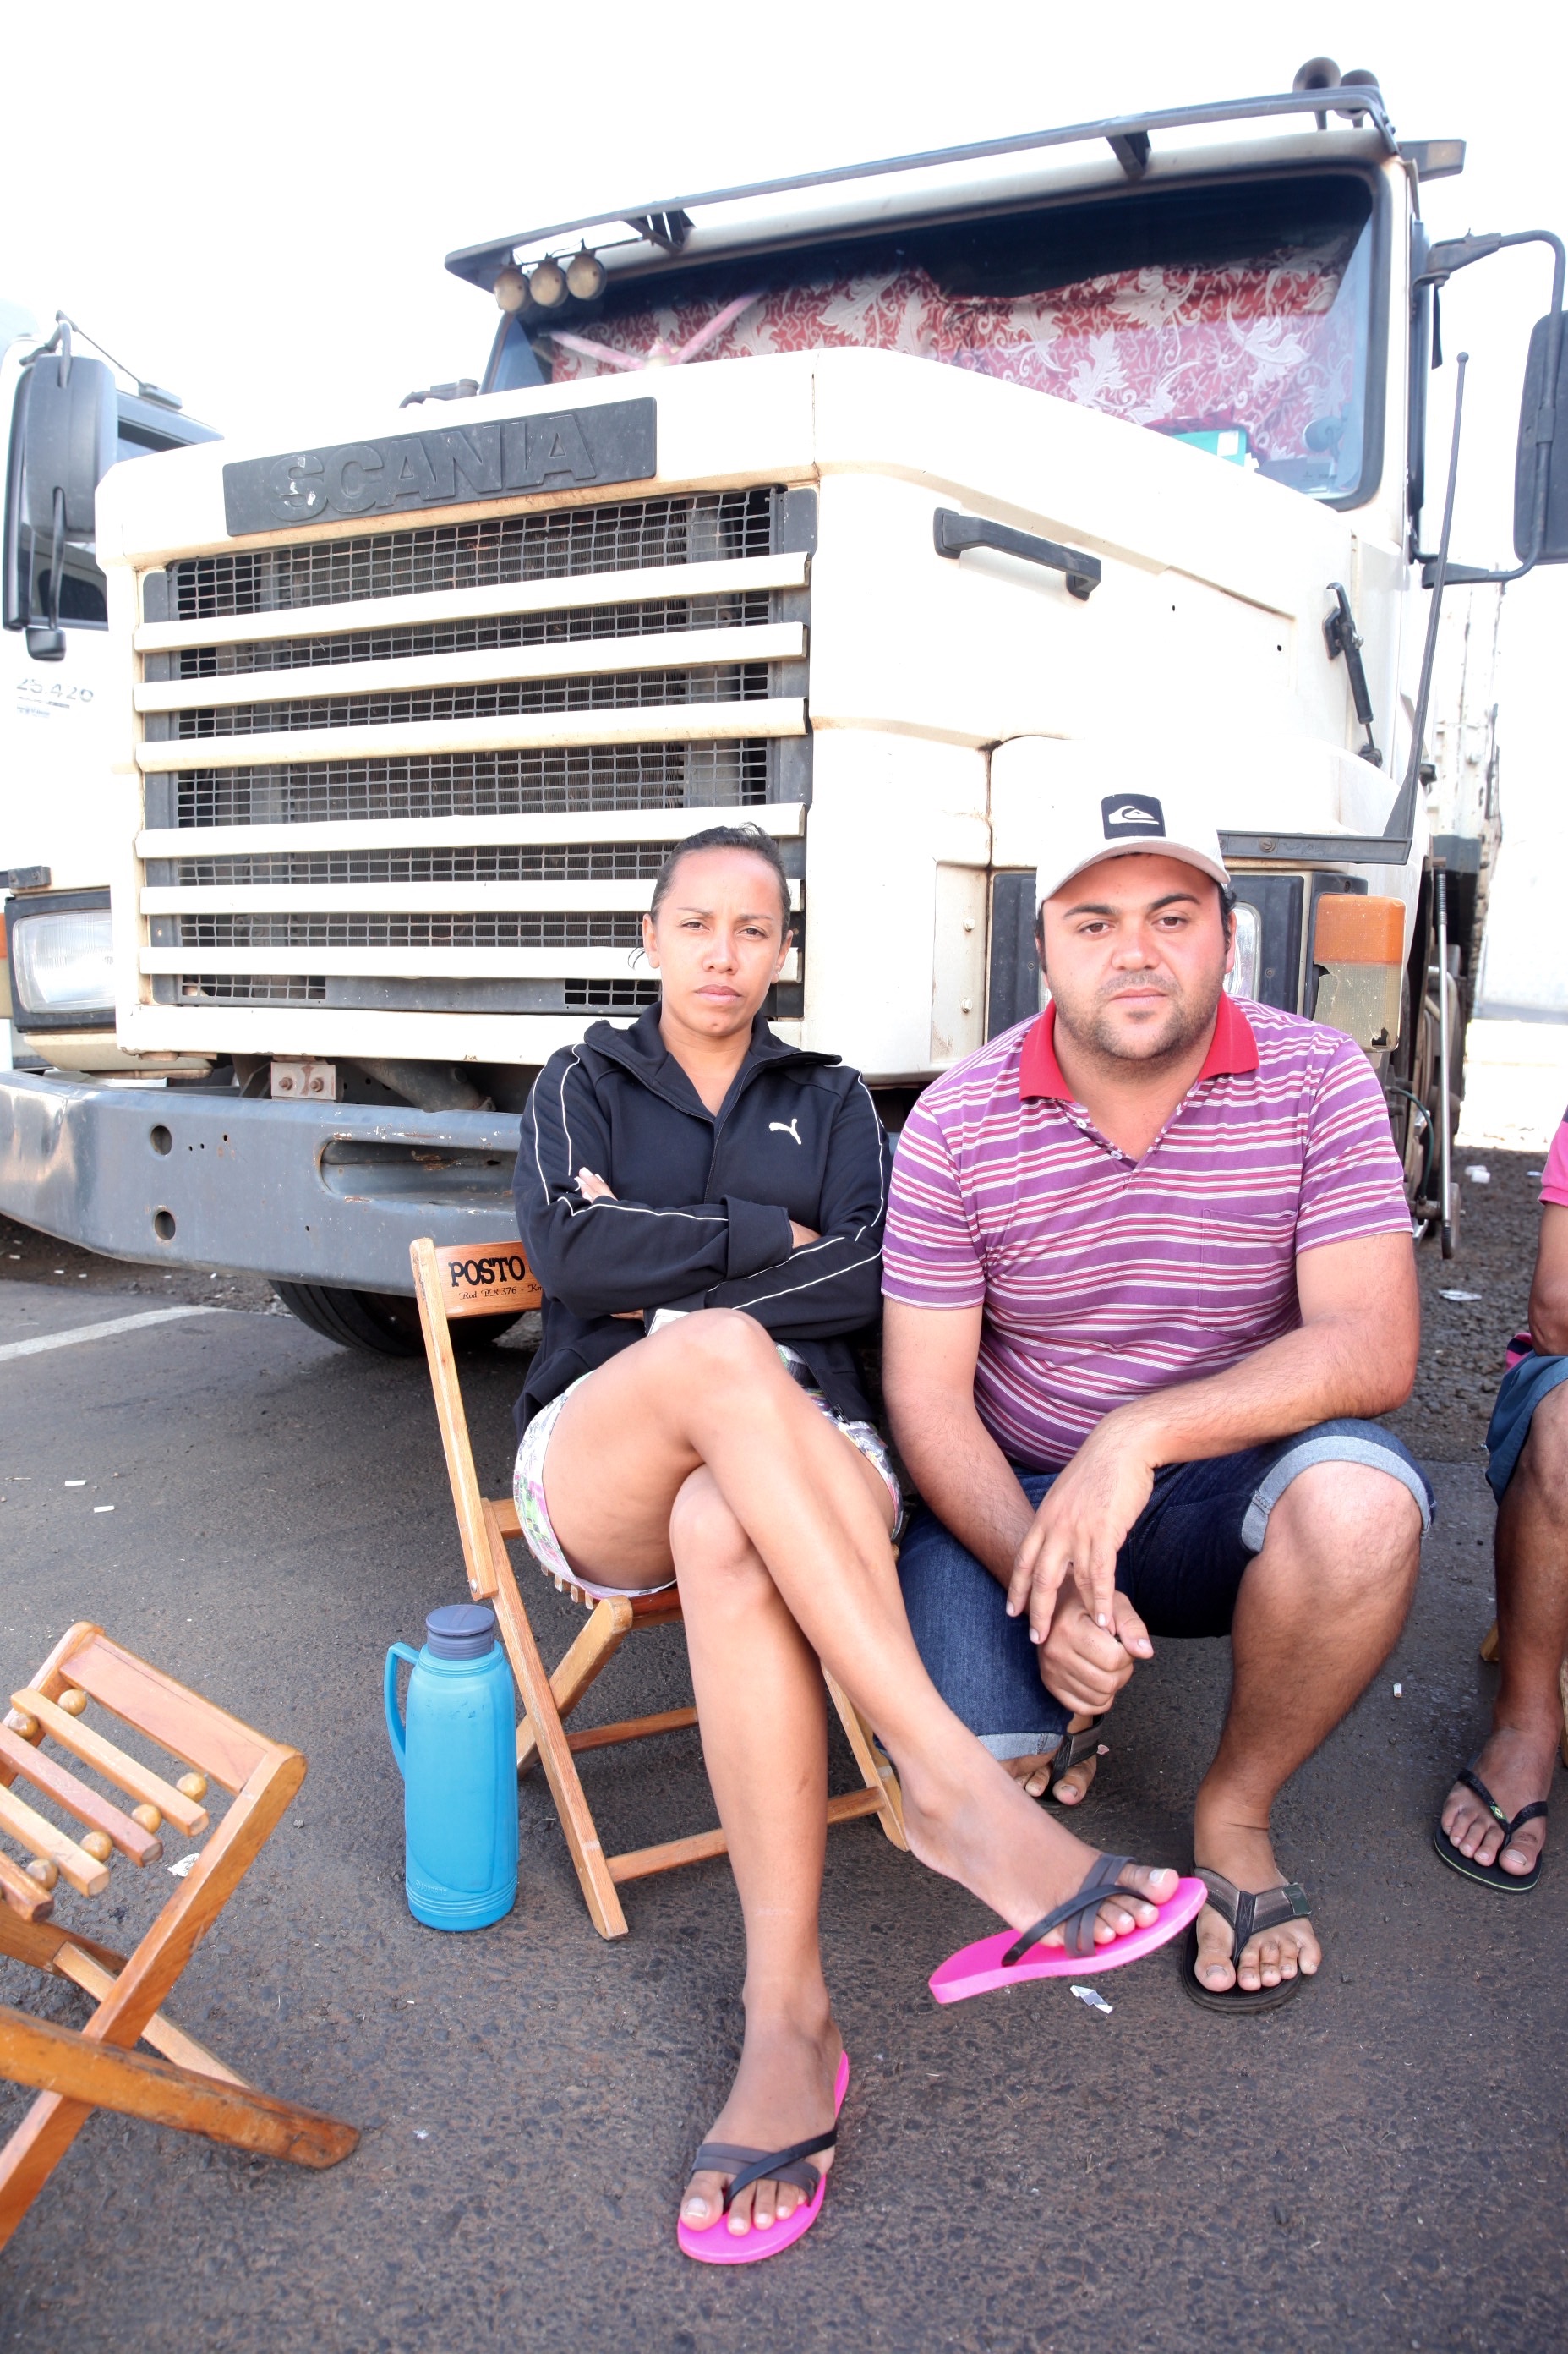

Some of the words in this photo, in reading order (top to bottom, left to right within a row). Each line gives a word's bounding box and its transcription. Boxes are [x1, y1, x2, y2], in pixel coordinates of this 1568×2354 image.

[269, 413, 597, 522] SCANIA
[16, 678, 94, 703] 25.420
[448, 1255, 526, 1287] POSTO
[480, 1288, 500, 1297] BR
[500, 1285, 517, 1295] 376
